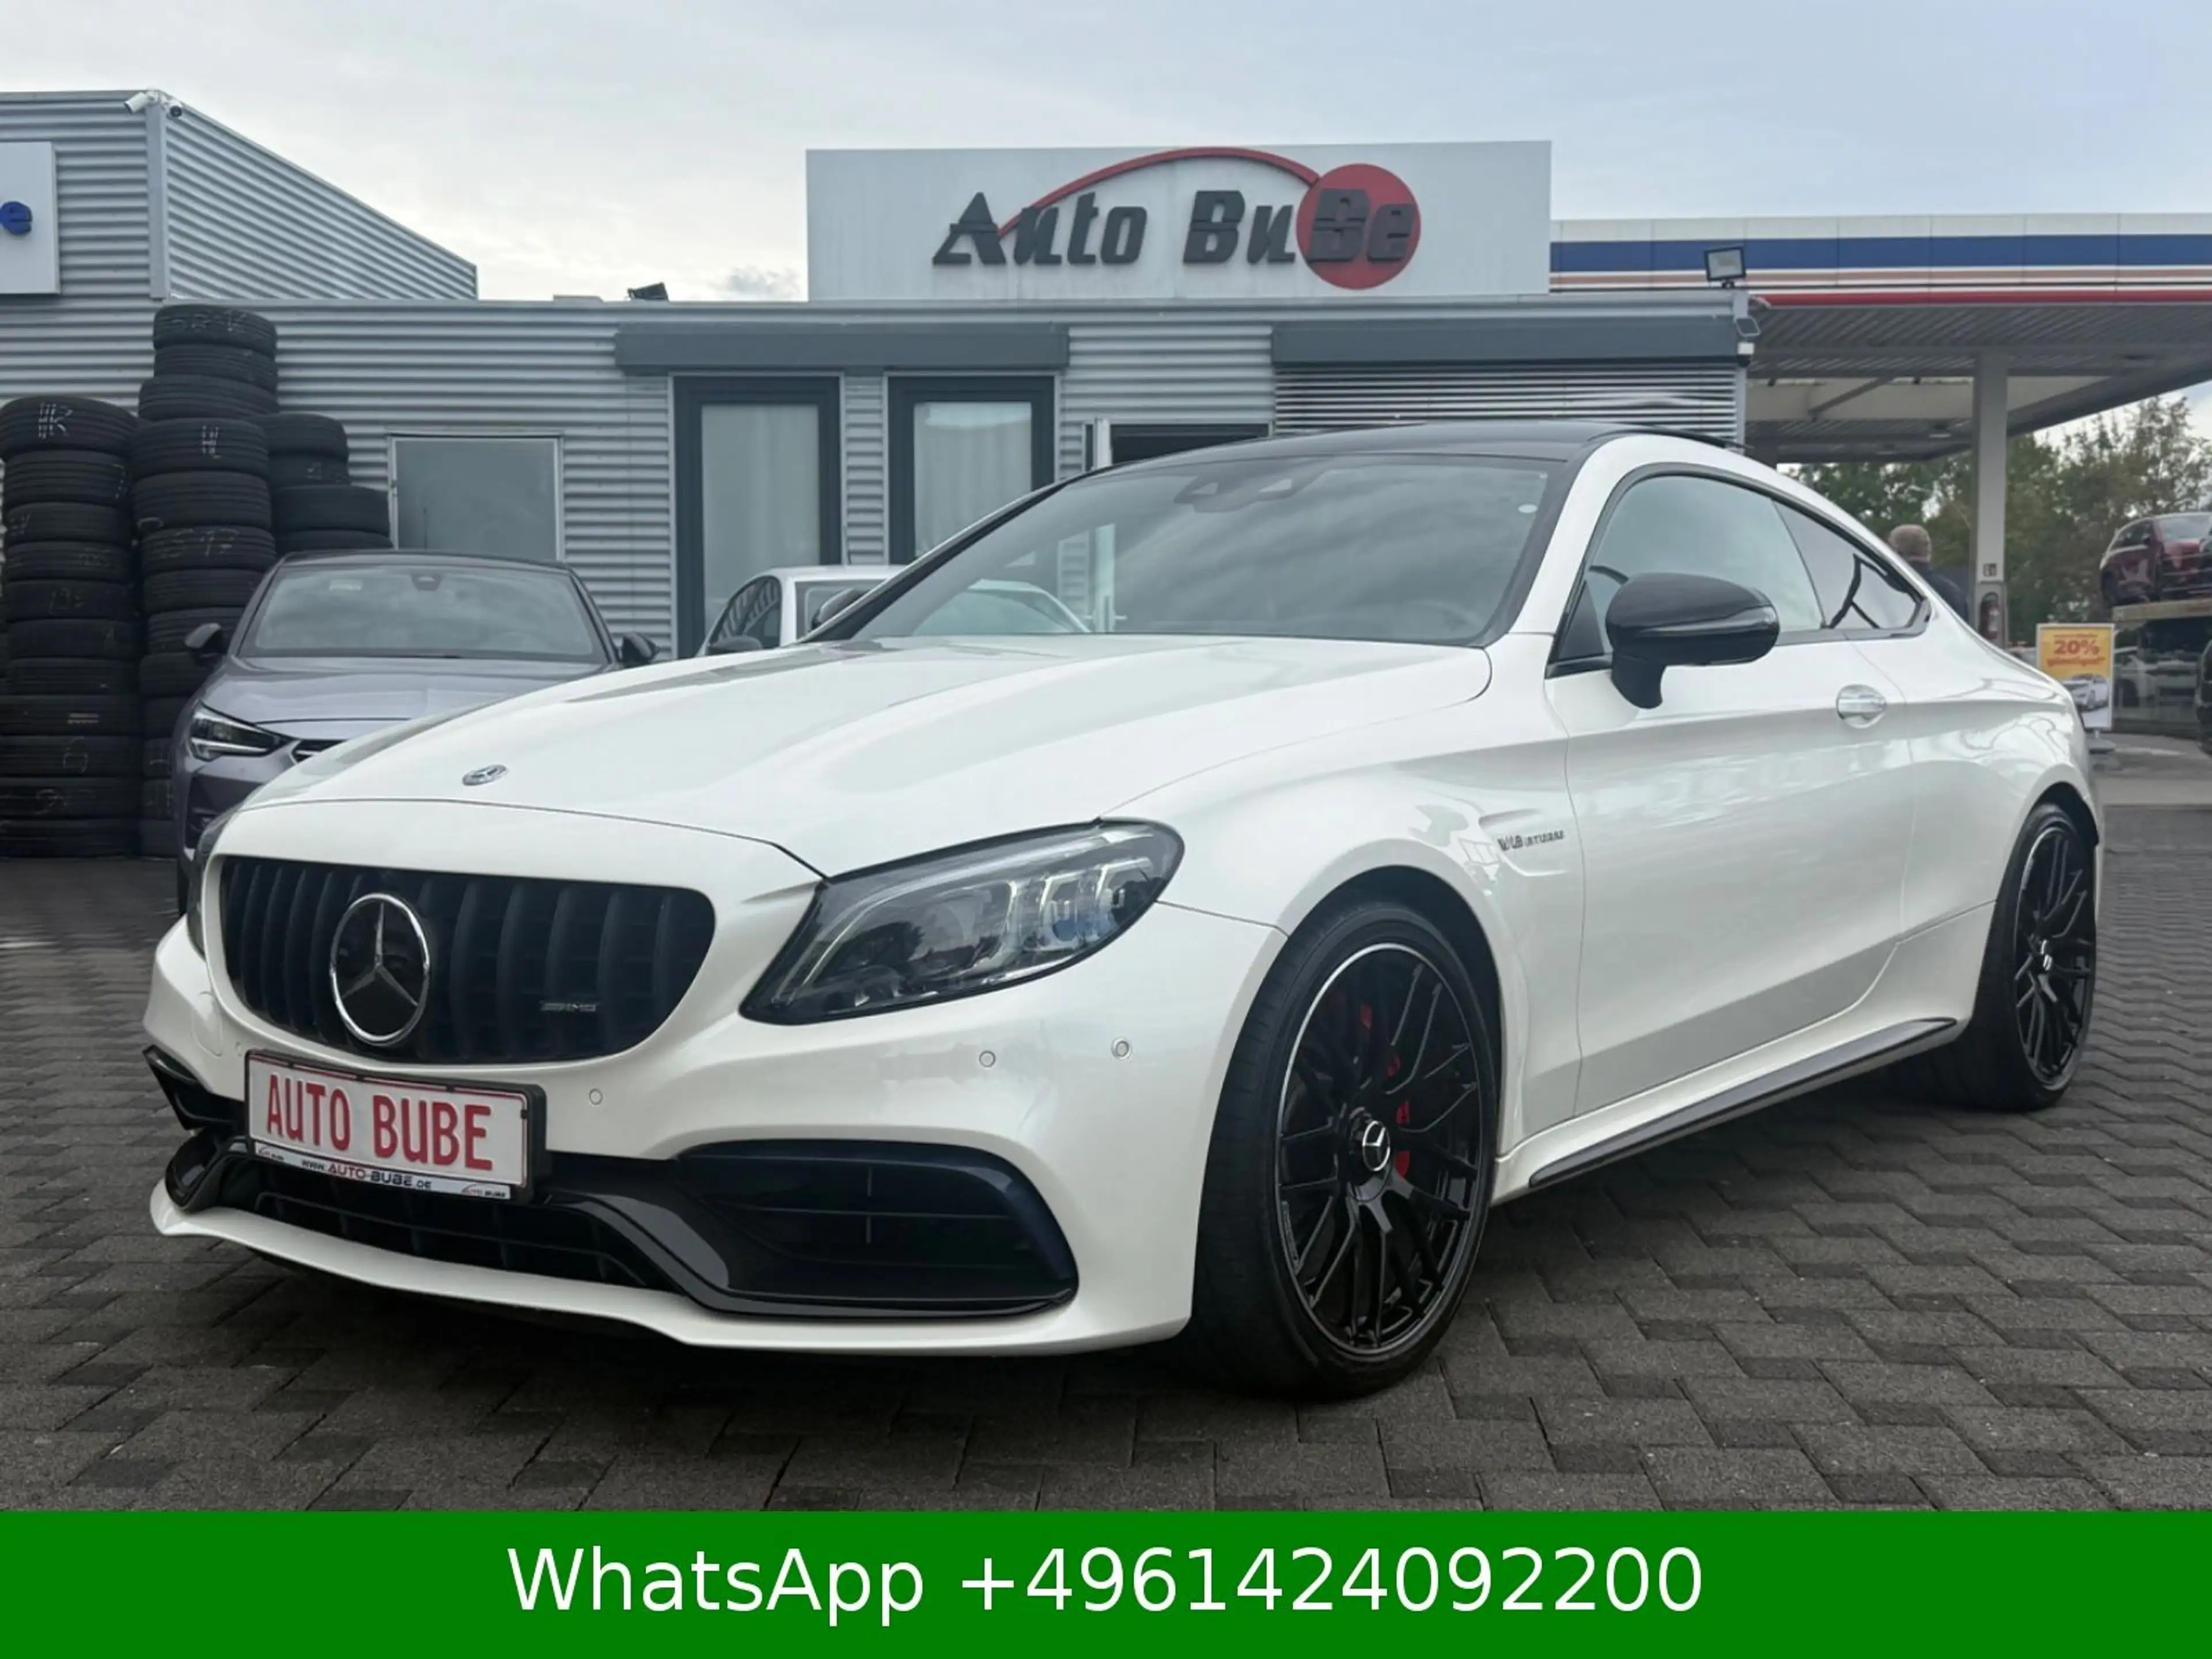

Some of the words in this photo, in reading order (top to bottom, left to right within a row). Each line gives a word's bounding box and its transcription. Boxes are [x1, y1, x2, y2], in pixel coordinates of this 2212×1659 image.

[932, 191, 1147, 266] Auto
[2054, 639, 2100, 655] 20%
[267, 1074, 351, 1151] AUTO
[372, 1094, 493, 1171] BUBE
